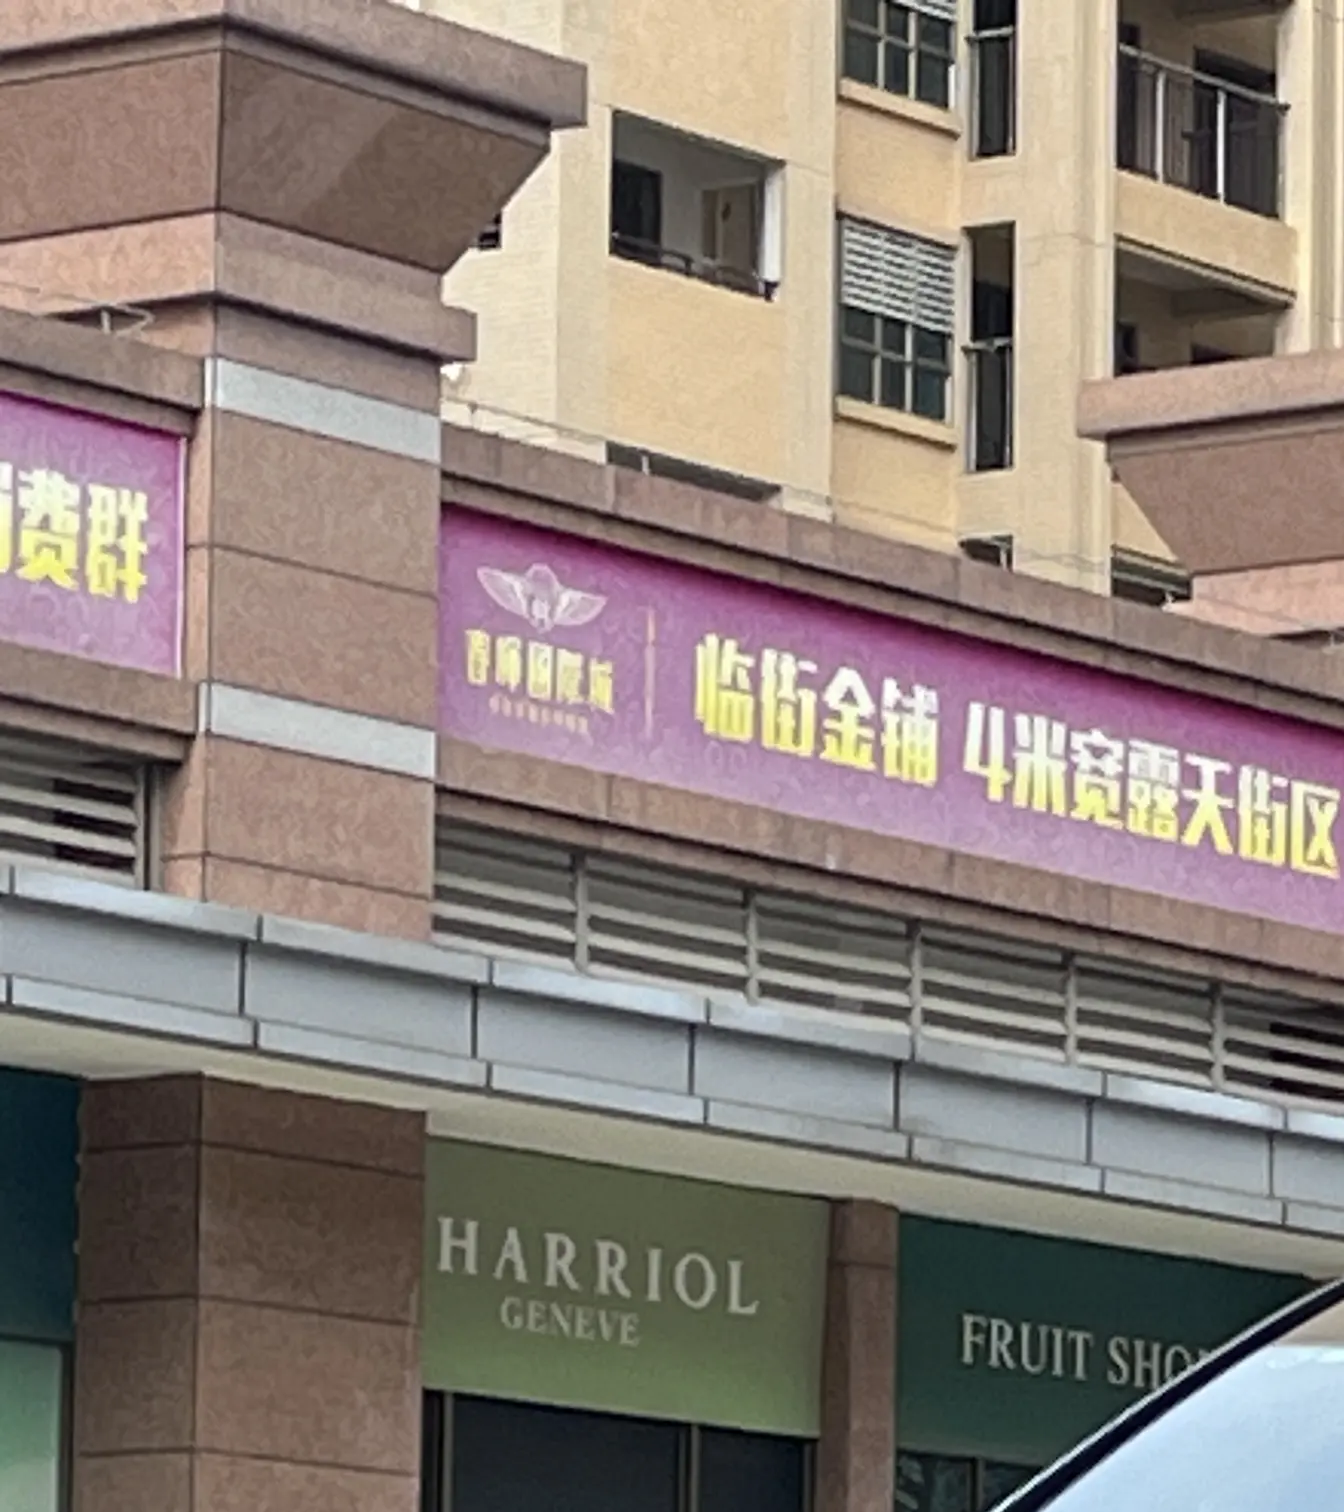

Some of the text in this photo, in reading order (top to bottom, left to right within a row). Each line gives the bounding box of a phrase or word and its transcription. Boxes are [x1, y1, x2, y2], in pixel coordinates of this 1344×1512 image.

[0, 462, 148, 604] 费群
[695, 633, 940, 787] 临街金铺
[963, 701, 1341, 879] 4米宽露天街区
[437, 1216, 760, 1315] HARRIOL
[500, 1295, 641, 1347] GENEVE
[961, 1312, 1093, 1381] FRUIT
